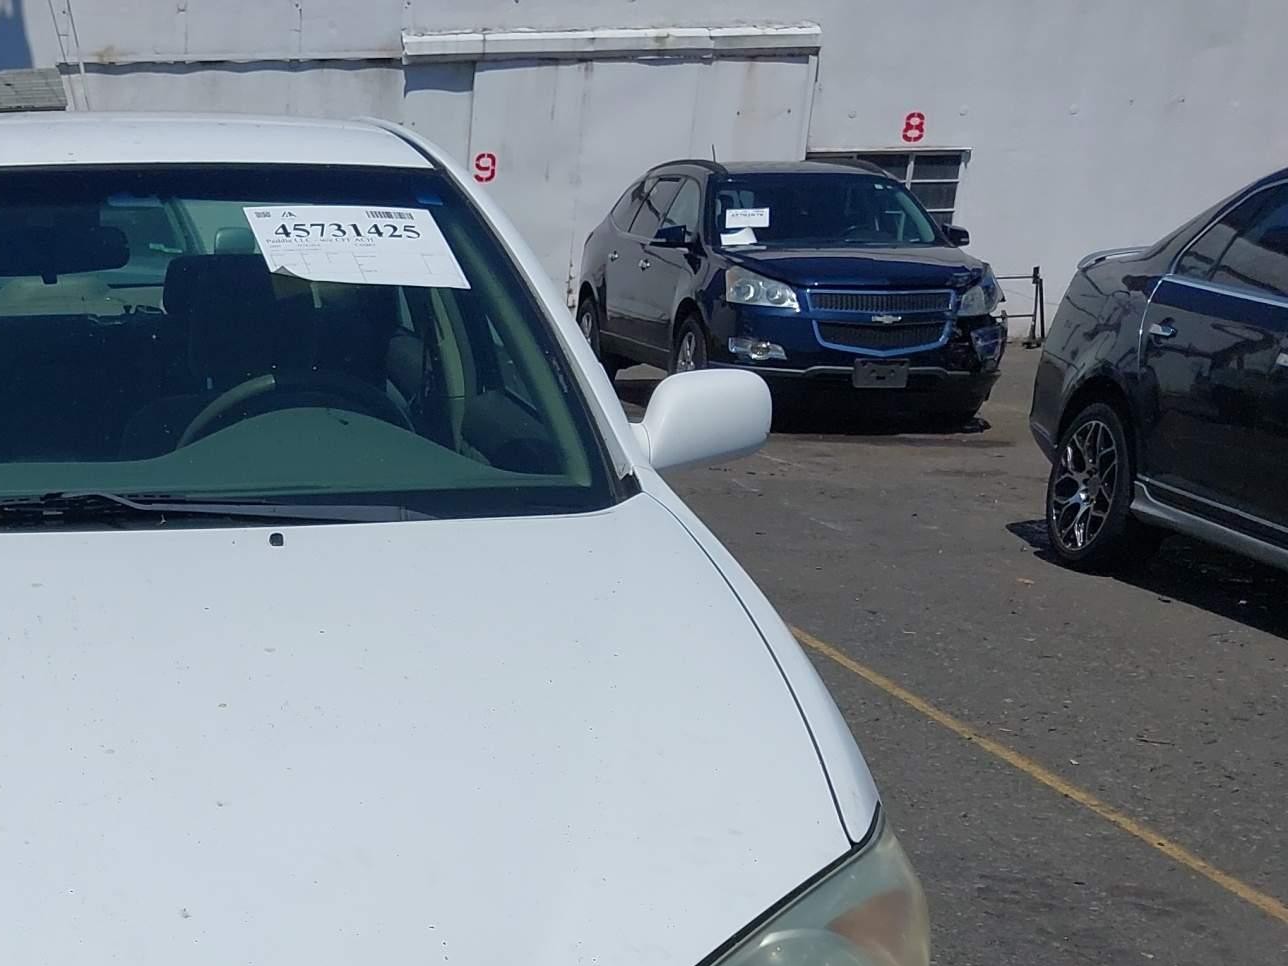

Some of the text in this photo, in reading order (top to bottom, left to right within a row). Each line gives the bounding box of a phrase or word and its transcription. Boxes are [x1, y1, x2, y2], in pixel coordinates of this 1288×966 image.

[902, 112, 925, 143] 8
[474, 153, 496, 182] 9
[274, 223, 421, 239] 45731425
